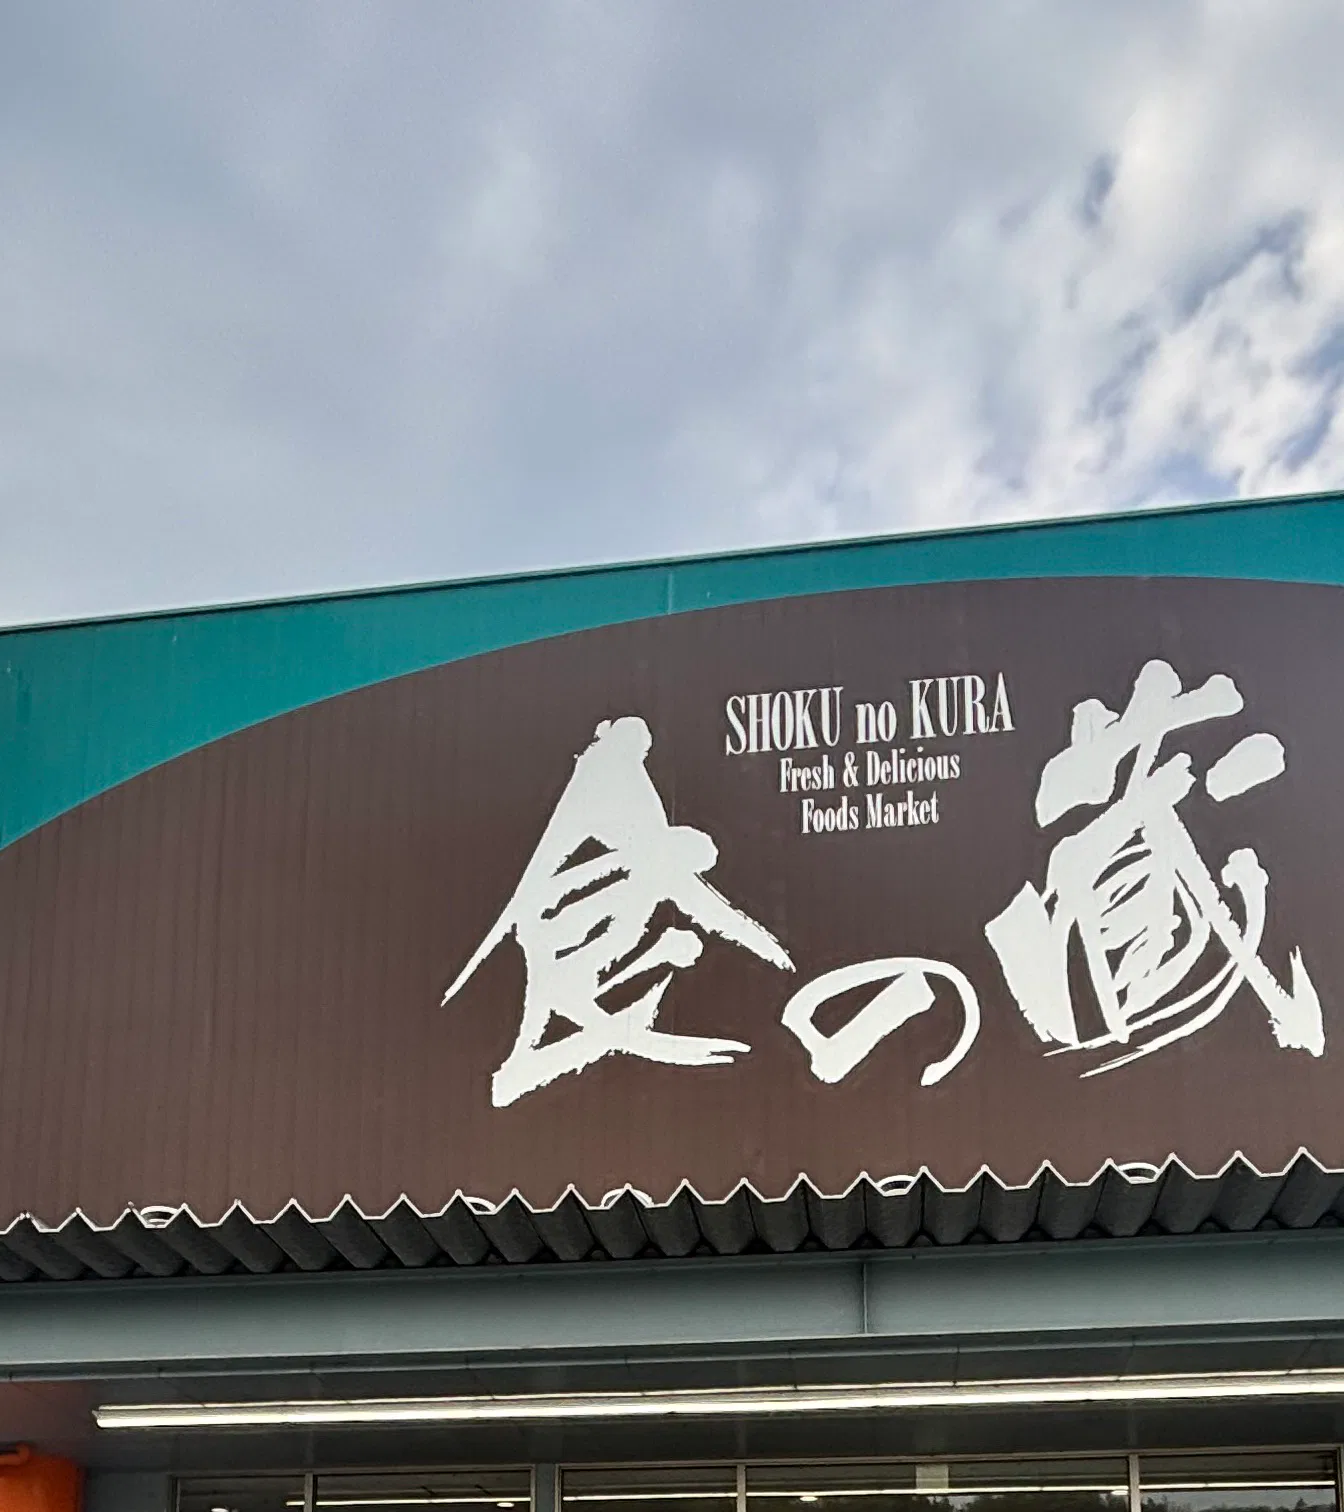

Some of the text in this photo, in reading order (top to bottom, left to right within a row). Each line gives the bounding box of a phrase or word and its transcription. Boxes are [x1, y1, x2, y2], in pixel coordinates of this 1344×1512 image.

[725, 672, 1016, 756] SHOKU no KURA
[779, 746, 960, 793] Fresh & Delicious
[801, 790, 940, 834] Foods Market
[441, 659, 1324, 1108] 食の蔵
